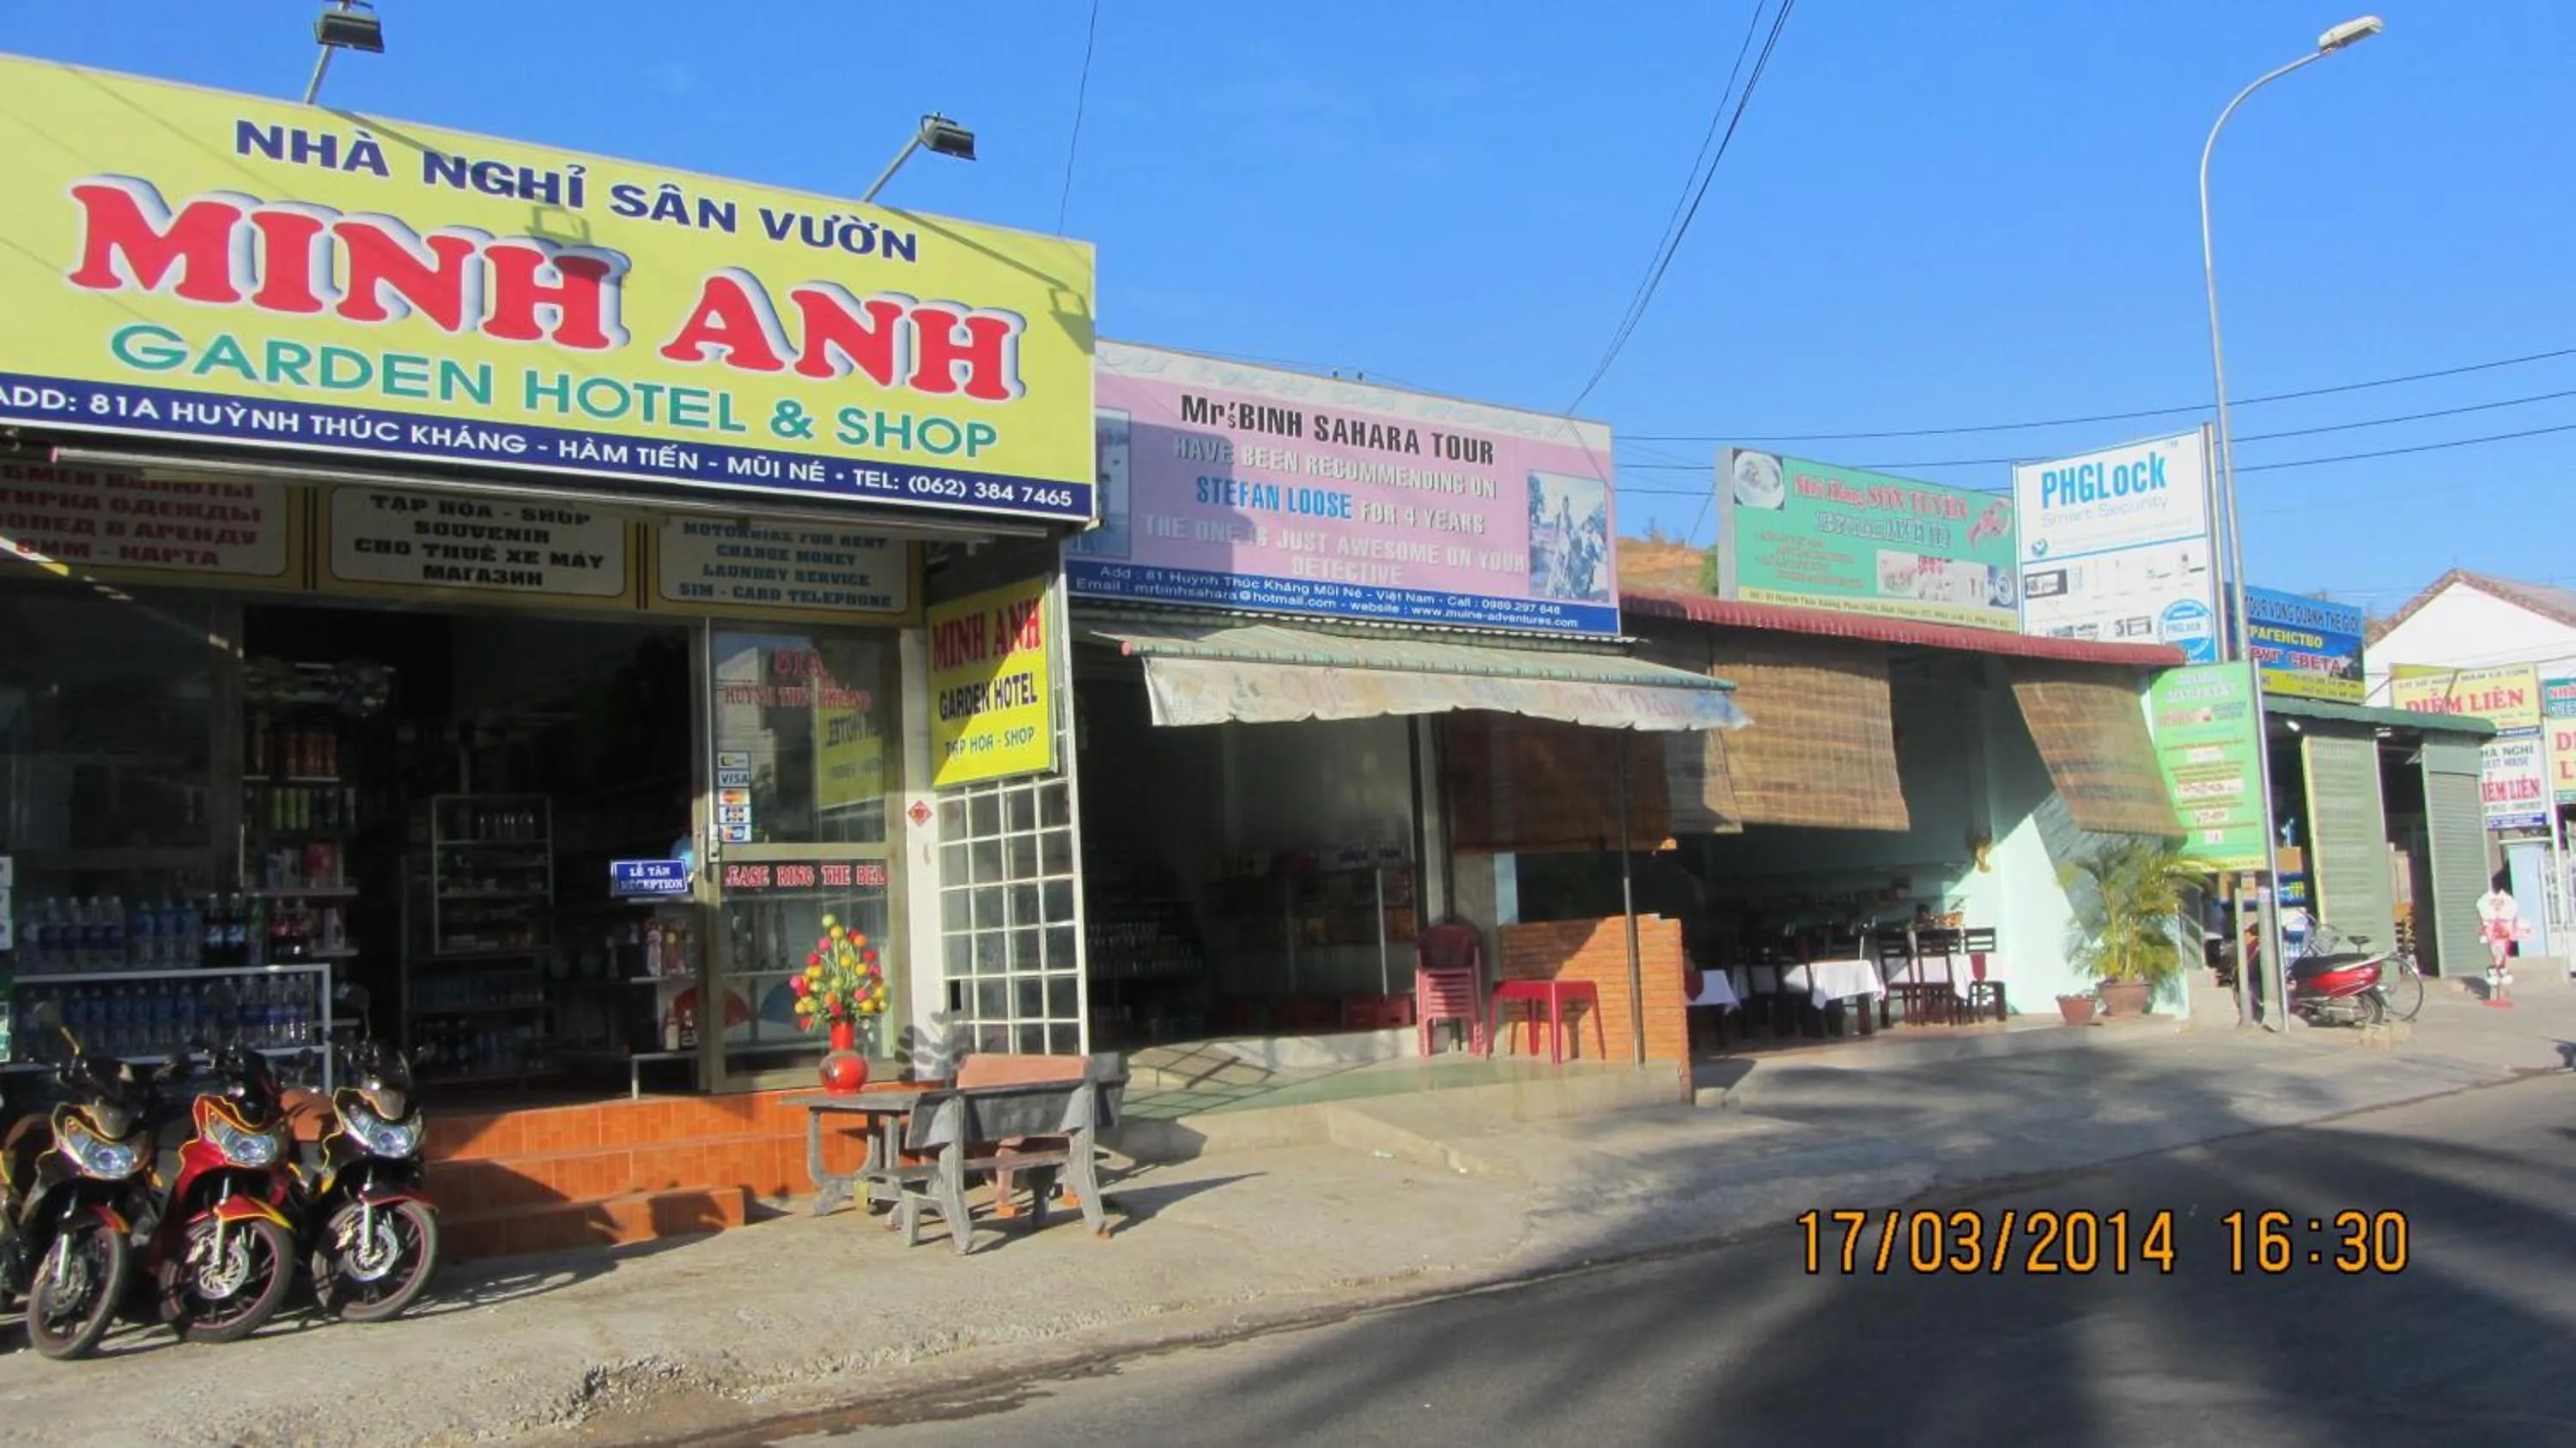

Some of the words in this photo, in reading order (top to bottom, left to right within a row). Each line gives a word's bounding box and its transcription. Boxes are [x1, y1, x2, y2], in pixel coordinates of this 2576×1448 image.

[236, 119, 390, 177] NHÀ
[423, 149, 586, 209] NGHỈ
[611, 183, 736, 233] SÂN
[759, 209, 917, 263] VƯỜN
[68, 176, 629, 350] MINH
[659, 266, 1027, 402] ANH
[111, 325, 492, 405] GARDEN
[526, 370, 746, 432] HOTEL
[771, 399, 815, 440] &
[838, 407, 998, 458] SHOP
[0, 387, 76, 412] ADD:
[90, 394, 160, 420] 81A
[172, 398, 300, 433] HUỲNH
[311, 409, 400, 442] THÚC
[411, 419, 526, 455] KHÁNG
[559, 433, 629, 465] HÀM
[637, 444, 698, 472] TIẾN
[728, 454, 785, 479] MŨI
[790, 459, 826, 484] NÉ
[854, 469, 899, 491] TEL:
[908, 473, 966, 500] (062)
[975, 480, 1014, 502] 384
[1021, 485, 1072, 508] 7465
[1239, 404, 1303, 438] BINH
[1314, 415, 1420, 455] SAHARA
[1431, 433, 1493, 465] TOUR
[1174, 435, 1234, 465] HAVE
[1243, 445, 1299, 474] BEEN
[1307, 455, 1466, 495] RECOMMENDING
[1471, 477, 1497, 500] ON
[1196, 475, 1279, 512] STEFAN
[1288, 488, 1352, 520] LOOSE
[1362, 502, 1398, 526] FOR
[1425, 508, 1485, 534] YEARS
[2042, 508, 2093, 528] Smart
[2098, 496, 2170, 518] Security
[414, 520, 550, 545] SOUVENIR
[354, 538, 411, 557] CHO
[506, 549, 540, 565] XE
[716, 544, 791, 562] CHANGE
[796, 551, 858, 566] MONEY
[1278, 529, 1327, 554] JUST
[1338, 536, 1440, 564] AWESOME
[1447, 547, 1472, 567] ON
[1480, 551, 1525, 573] YOUR
[703, 563, 788, 581] LAUNDRY
[795, 570, 871, 587] SERVICE
[1292, 557, 1403, 585] DETECTIVE
[1406, 593, 1435, 605] Nam
[933, 611, 986, 672] MINH
[993, 596, 1042, 657] ANH
[2250, 624, 2324, 649] РАГЕНСТВО
[939, 684, 990, 721] GARDEN
[994, 672, 1038, 710] HOTEL
[1004, 726, 1035, 748] SHOP
[721, 773, 749, 784] VISA
[725, 865, 770, 886] EASE
[821, 865, 851, 885] THE
